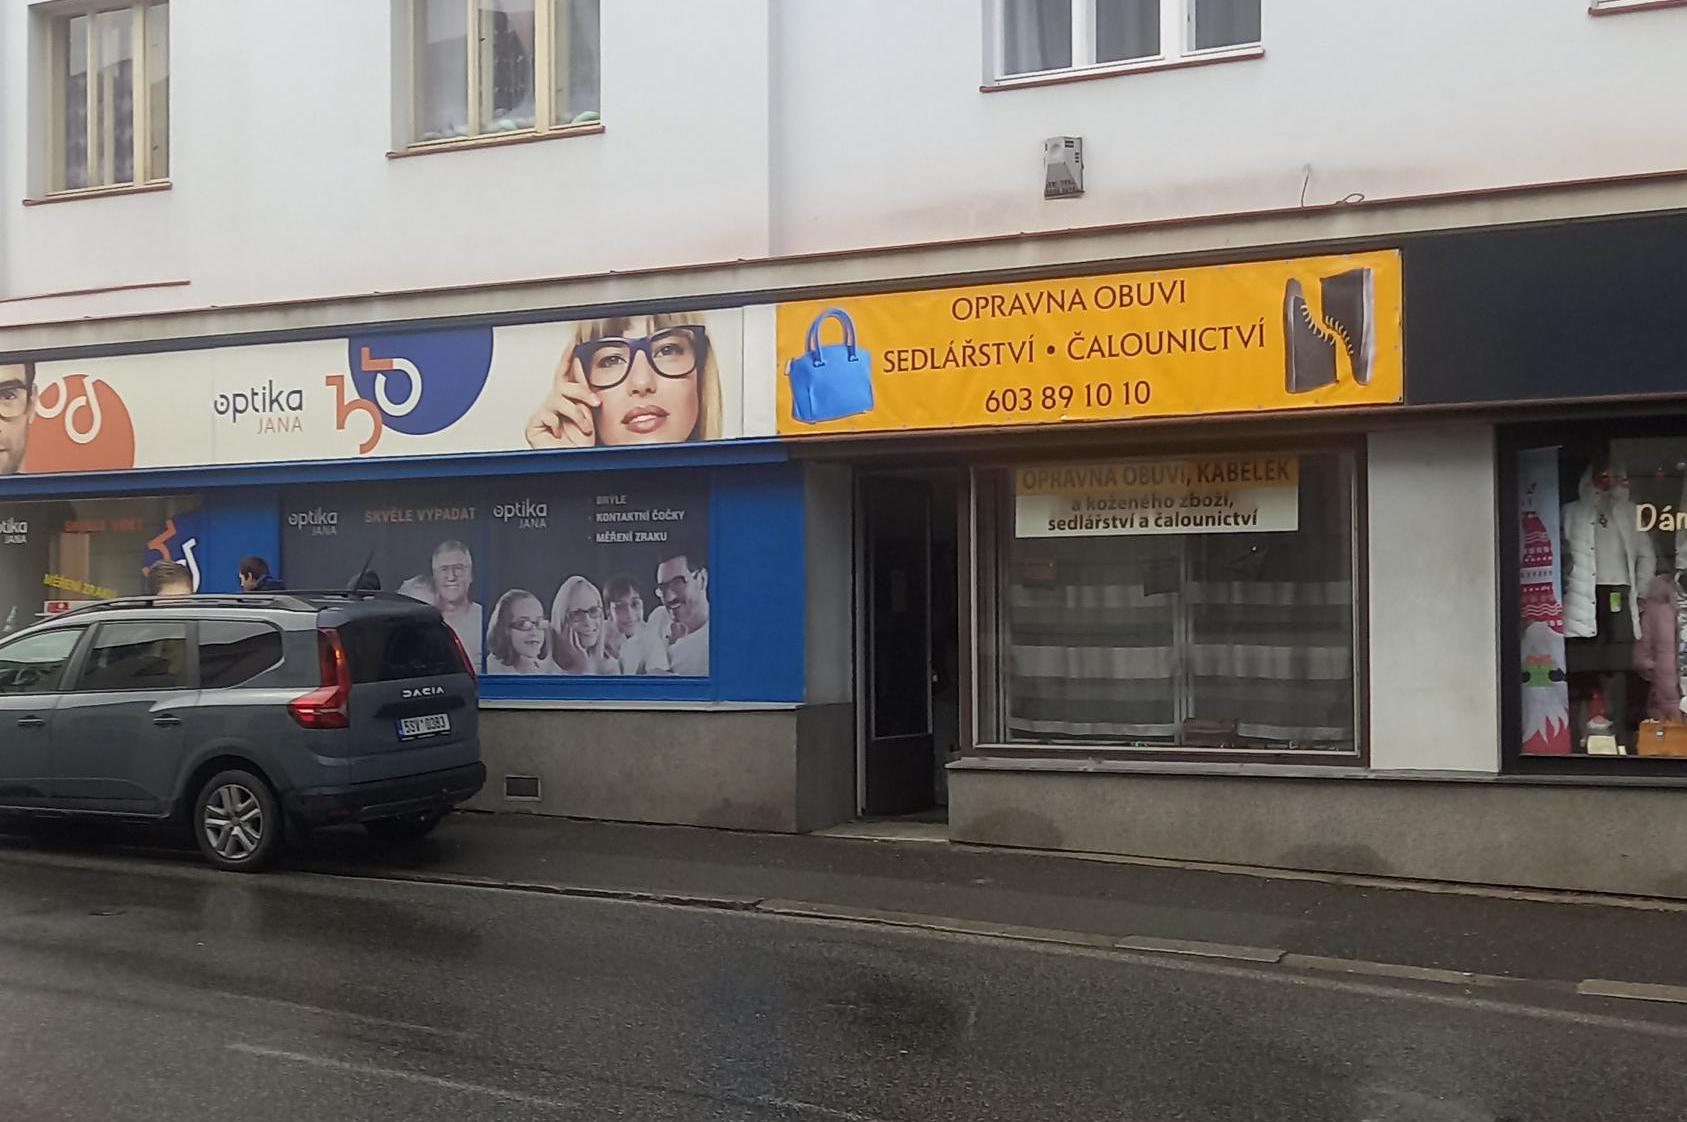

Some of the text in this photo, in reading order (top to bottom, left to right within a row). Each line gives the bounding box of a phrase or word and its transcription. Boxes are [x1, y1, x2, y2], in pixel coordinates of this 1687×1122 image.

[951, 280, 1186, 321] OPRAVNA OBUVI
[883, 317, 1266, 373] SEDLÁŘSTVÍ ČALOUNICTVÍ
[214, 380, 303, 423] optika
[984, 380, 1151, 413] 603 89 10 10
[257, 417, 303, 434] JANA
[1022, 466, 1117, 490] OPRAVNA
[1197, 459, 1290, 483] KABELEK
[493, 498, 547, 521] optika
[1086, 495, 1174, 511] koženého
[1048, 508, 1258, 531] sedlářství a čalounictví
[402, 686, 444, 698] DACIA
